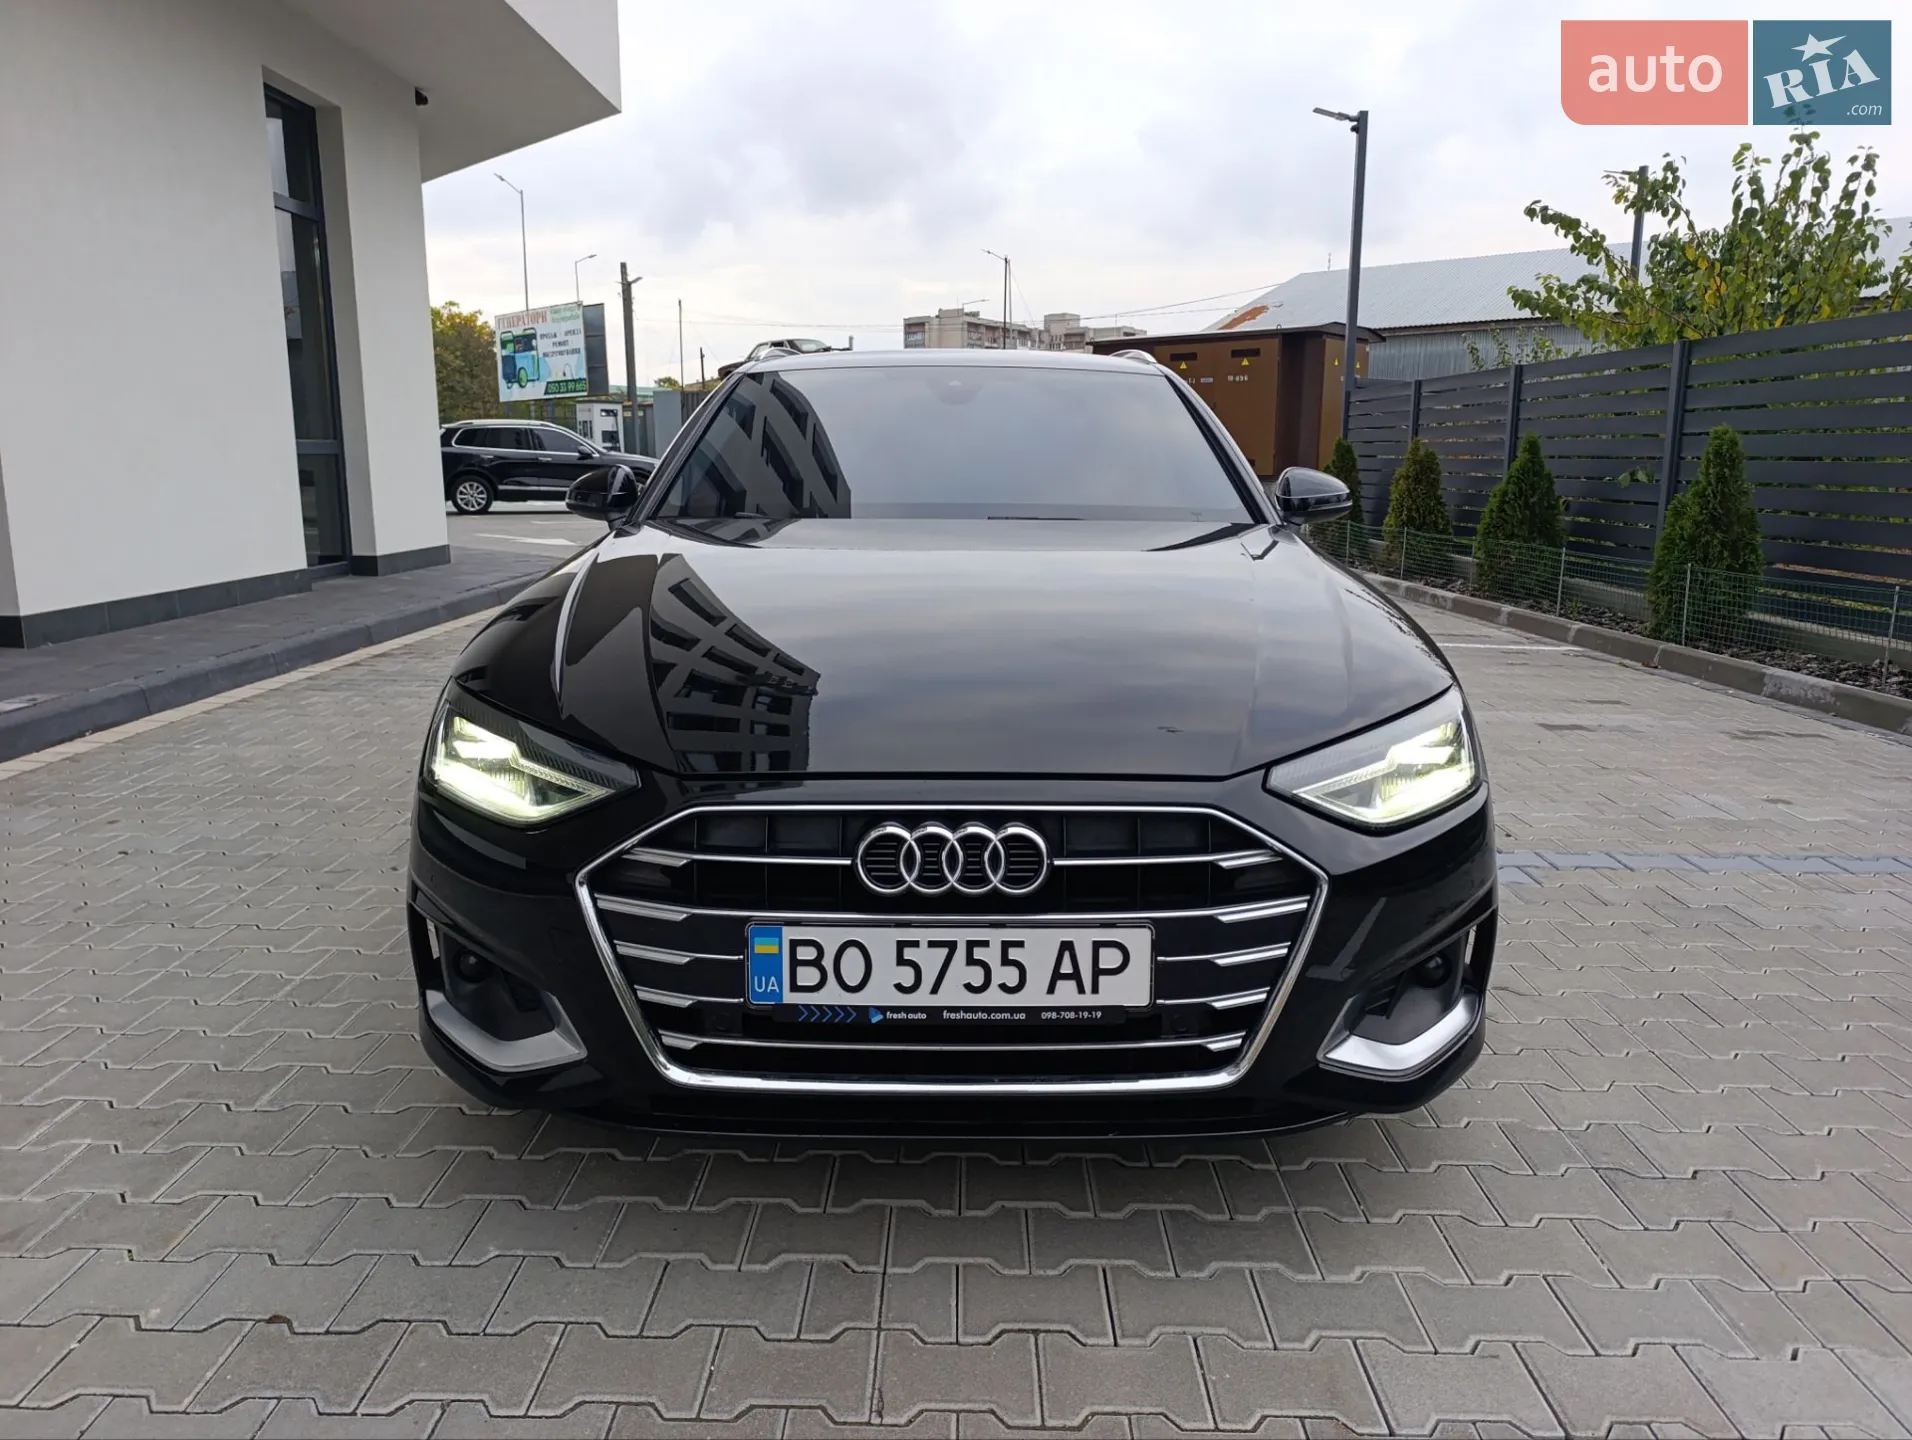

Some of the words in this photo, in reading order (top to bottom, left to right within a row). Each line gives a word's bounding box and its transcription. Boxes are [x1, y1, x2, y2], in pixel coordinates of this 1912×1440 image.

[788, 938, 873, 994] BO
[893, 939, 1027, 995] 5755
[1046, 939, 1131, 995] AP
[754, 976, 779, 993] UA
[886, 1011, 907, 1020] fresh
[908, 1012, 927, 1020] auto
[943, 1010, 1026, 1020] freshauto.com.ua
[1041, 1011, 1102, 1020] 098-708-19-19
